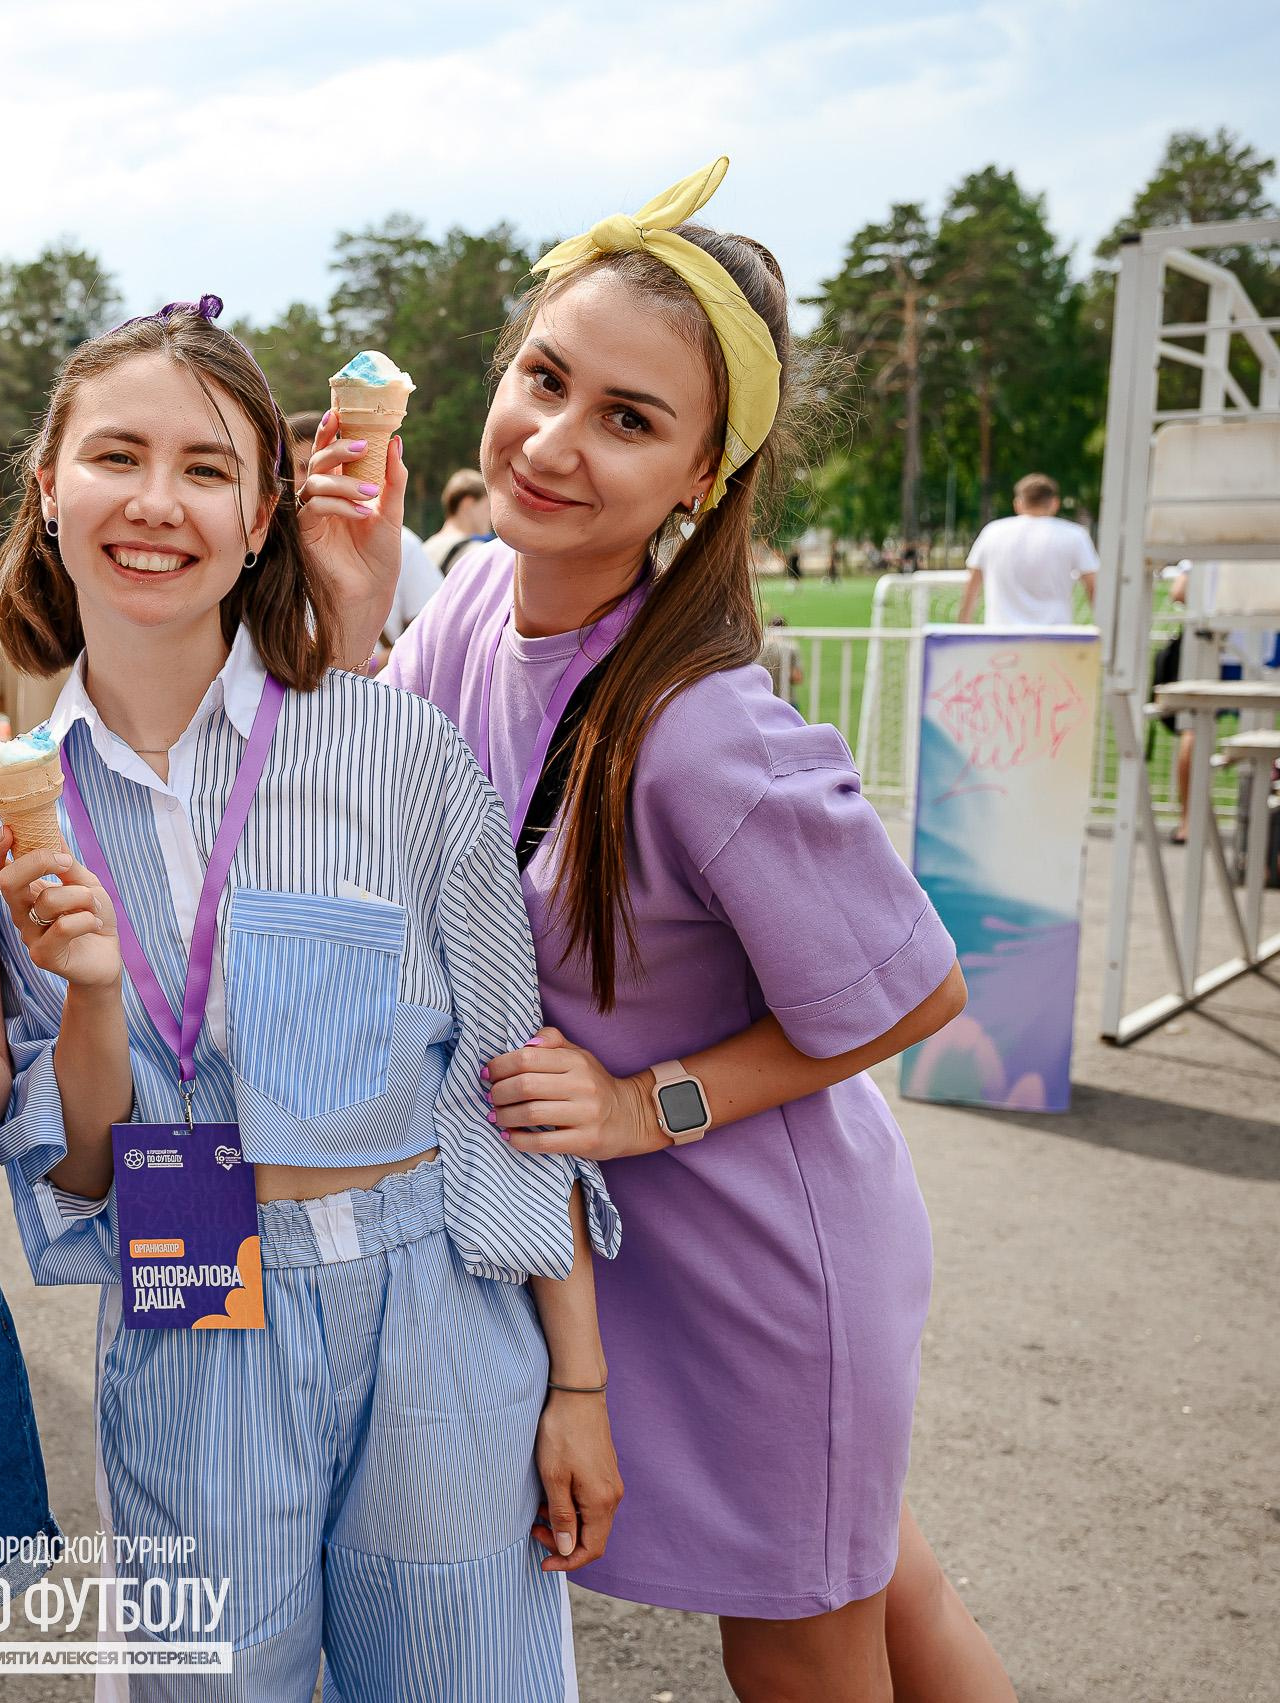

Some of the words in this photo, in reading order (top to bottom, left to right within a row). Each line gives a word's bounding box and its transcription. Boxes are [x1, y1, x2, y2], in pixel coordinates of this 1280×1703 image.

[134, 1243, 180, 1254] ОРГАНИЗАТОР
[131, 1264, 245, 1288] КОНОВАЛОВА
[133, 1287, 186, 1313] ДАША
